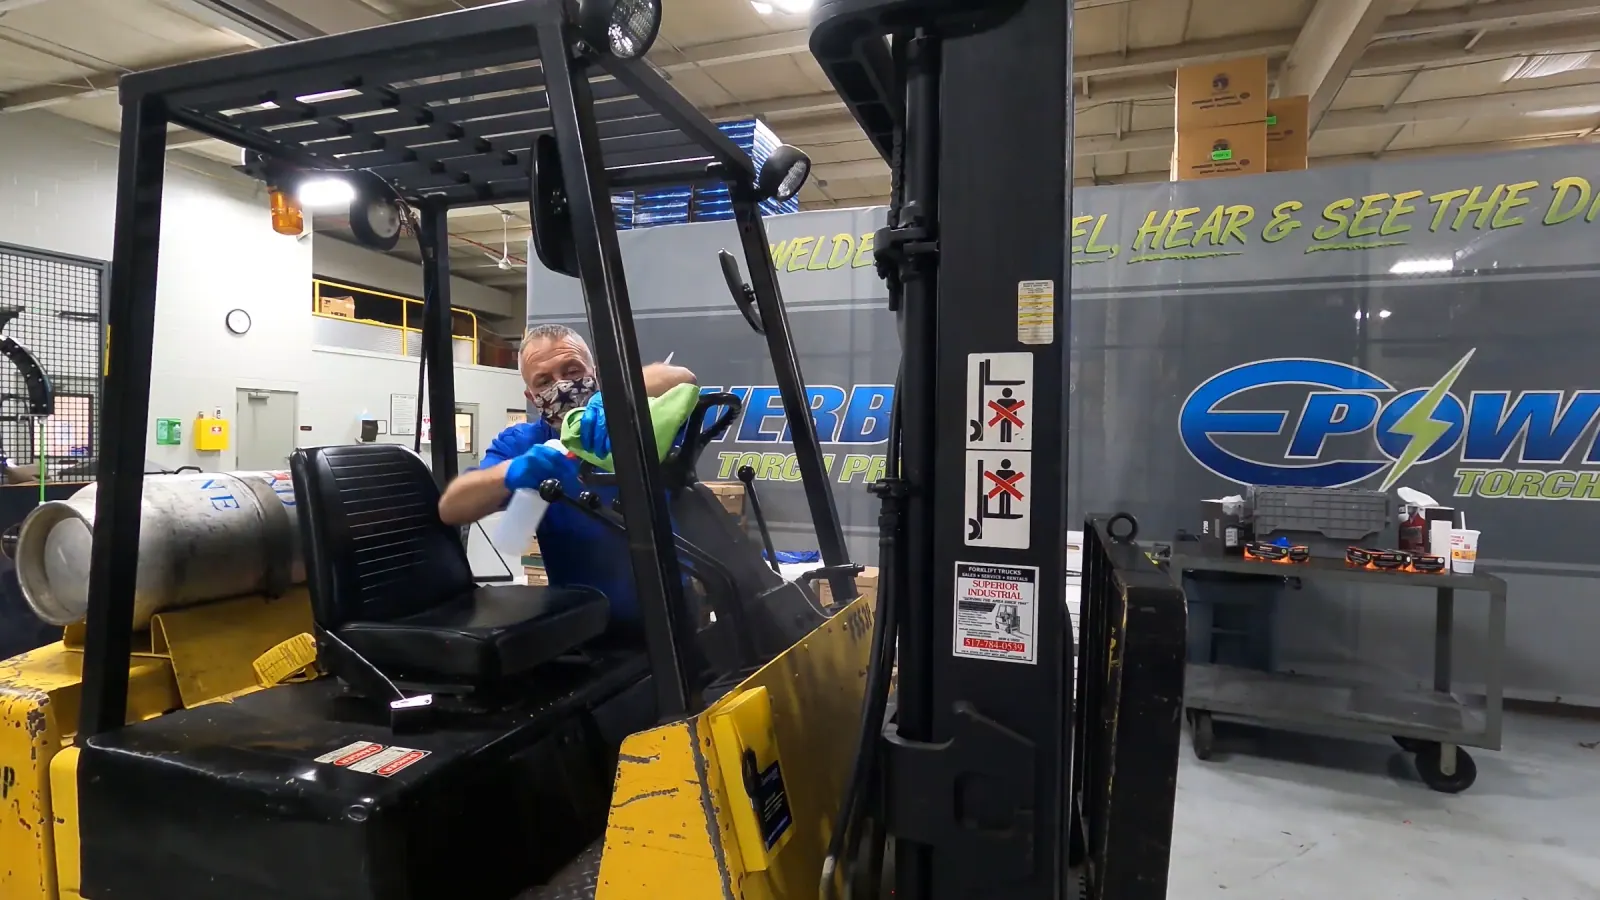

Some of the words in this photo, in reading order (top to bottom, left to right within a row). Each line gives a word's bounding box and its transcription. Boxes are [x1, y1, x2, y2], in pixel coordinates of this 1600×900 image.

[1131, 205, 1254, 250] HEAR
[1261, 200, 1303, 243] &
[1312, 189, 1424, 240] SEE
[1428, 180, 1539, 233] THE
[968, 566, 997, 574] FORKLIFT
[973, 580, 1018, 590] SUPERIOR
[968, 589, 1023, 599] INDUSTRIAL
[965, 639, 1022, 651] 517-784-0539
